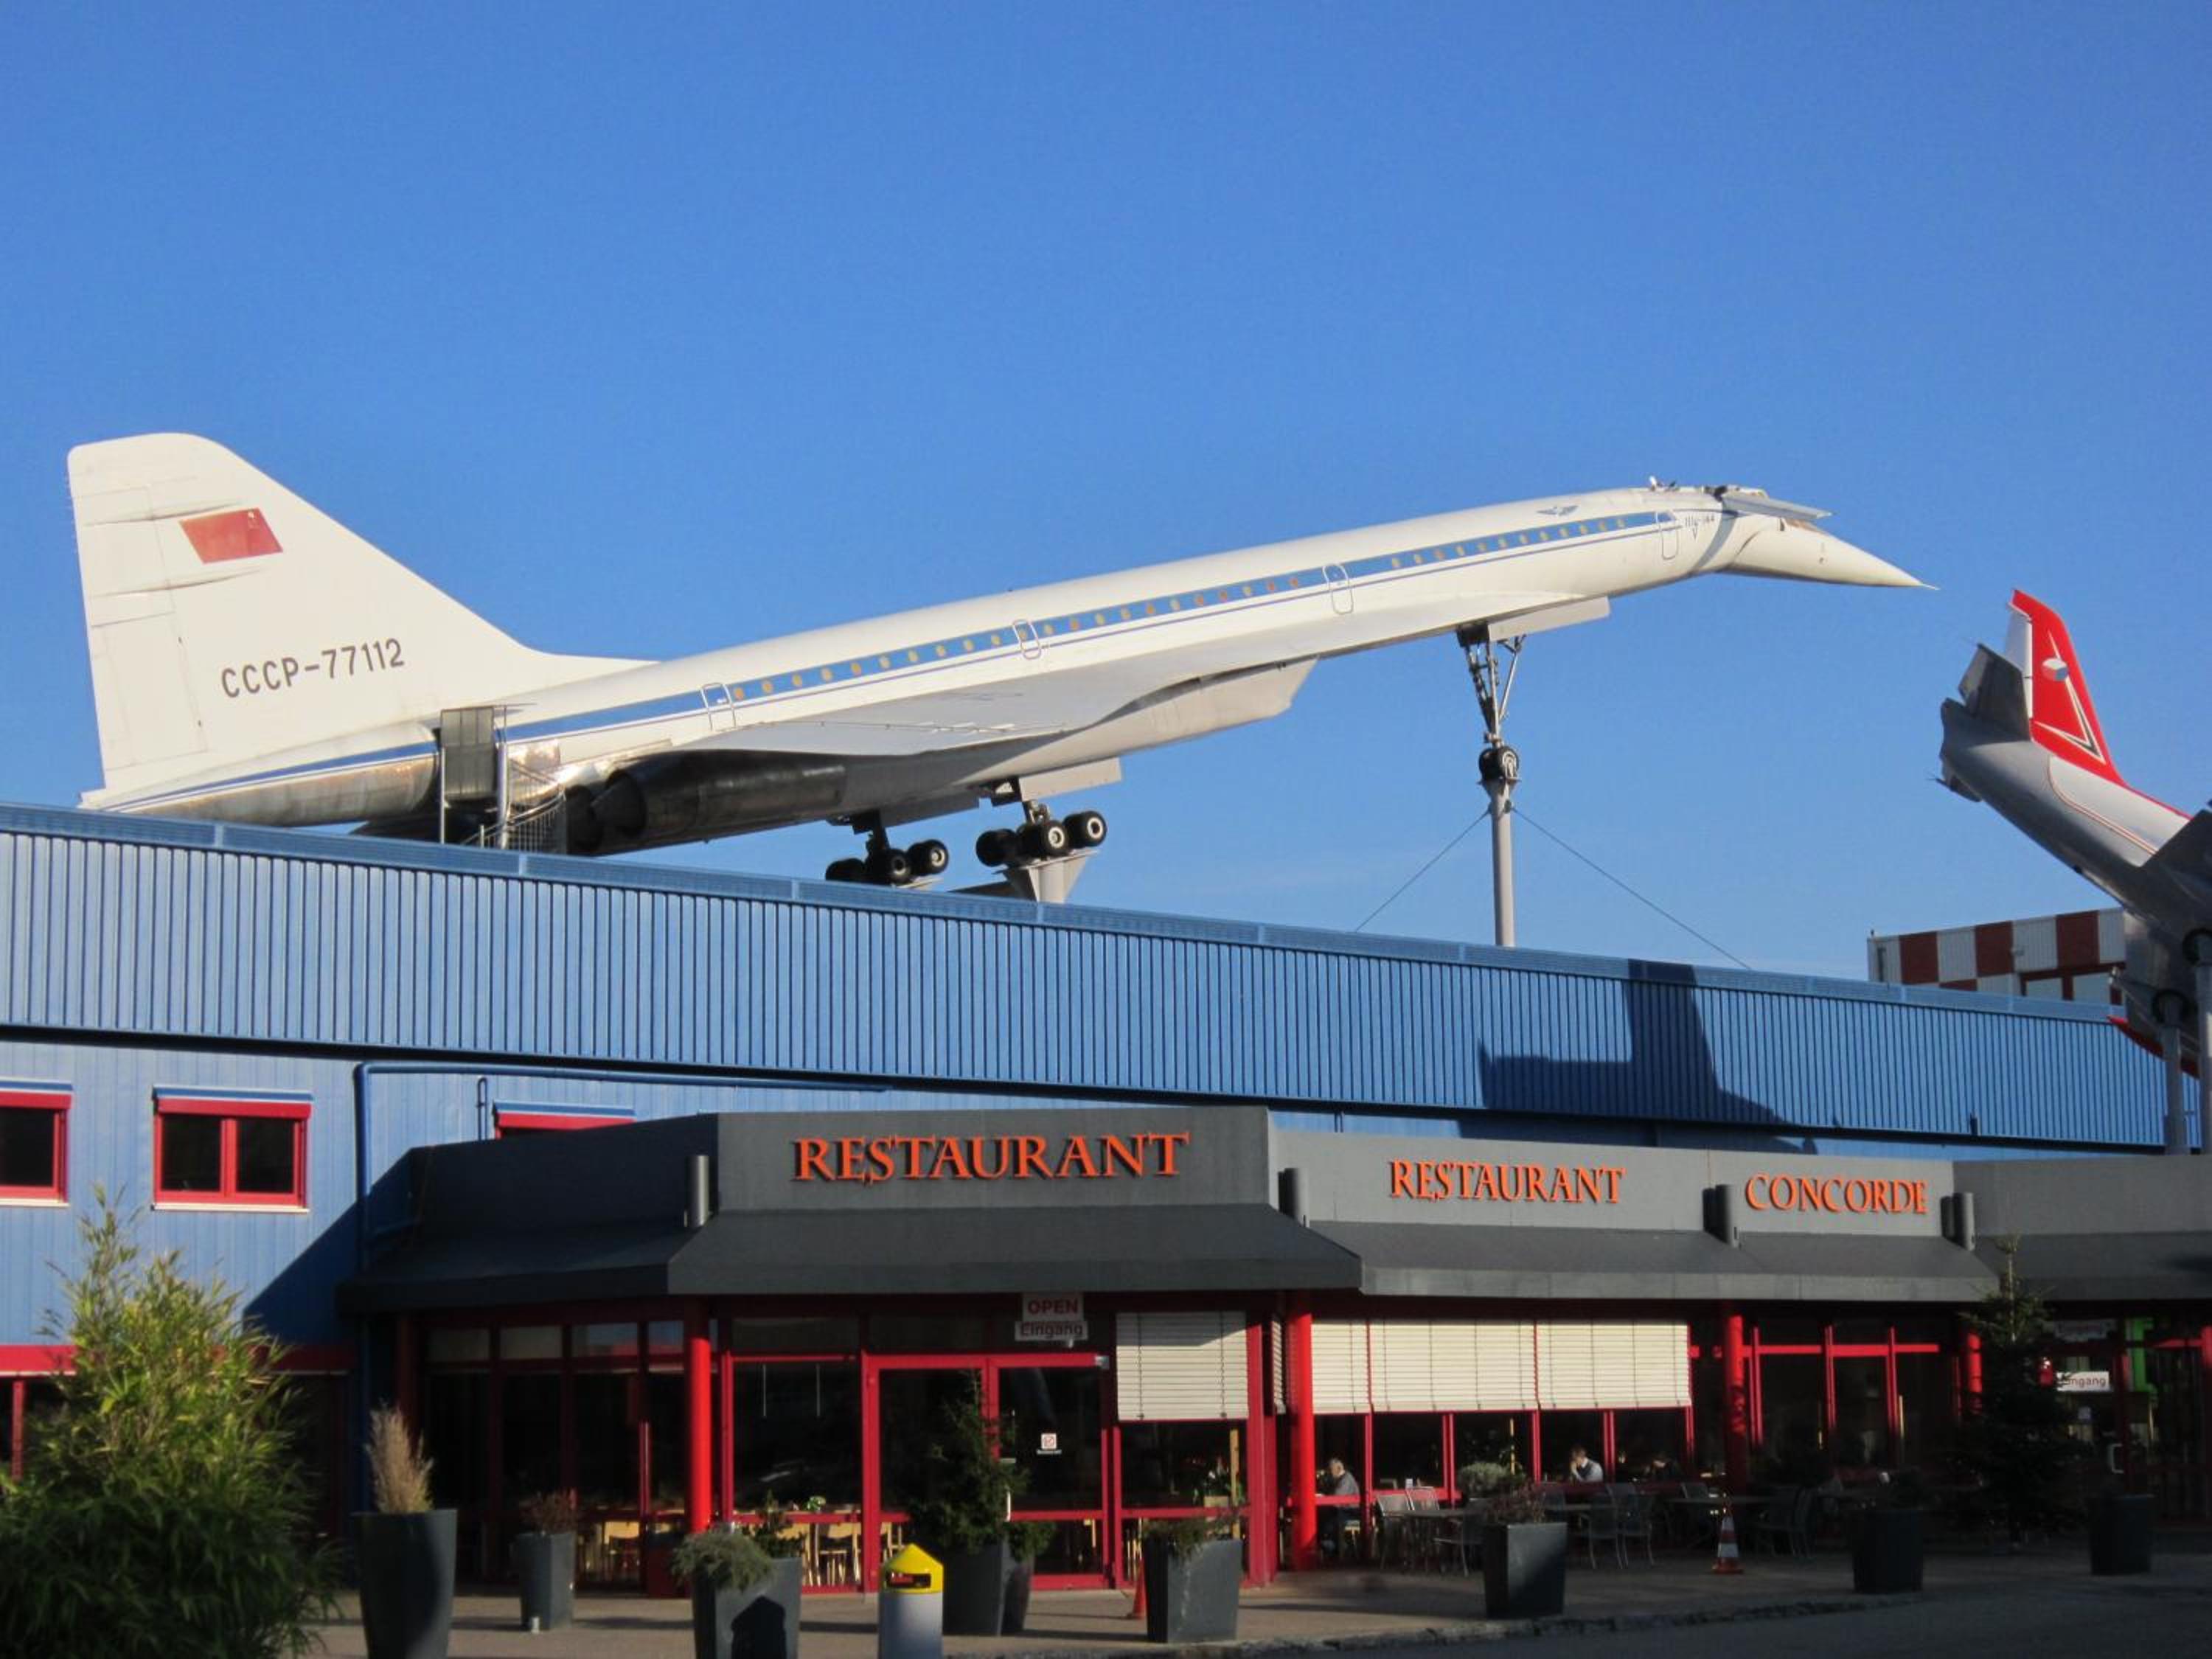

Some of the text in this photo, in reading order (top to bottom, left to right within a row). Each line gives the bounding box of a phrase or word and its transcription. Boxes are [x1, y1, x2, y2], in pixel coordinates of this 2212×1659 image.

[794, 1131, 1190, 1186] RESTAURANT
[1390, 1160, 1930, 1214] RESTAURANT CONCORDE
[1027, 1298, 1079, 1314] OPEN
[1020, 1321, 1083, 1340] Eingang
